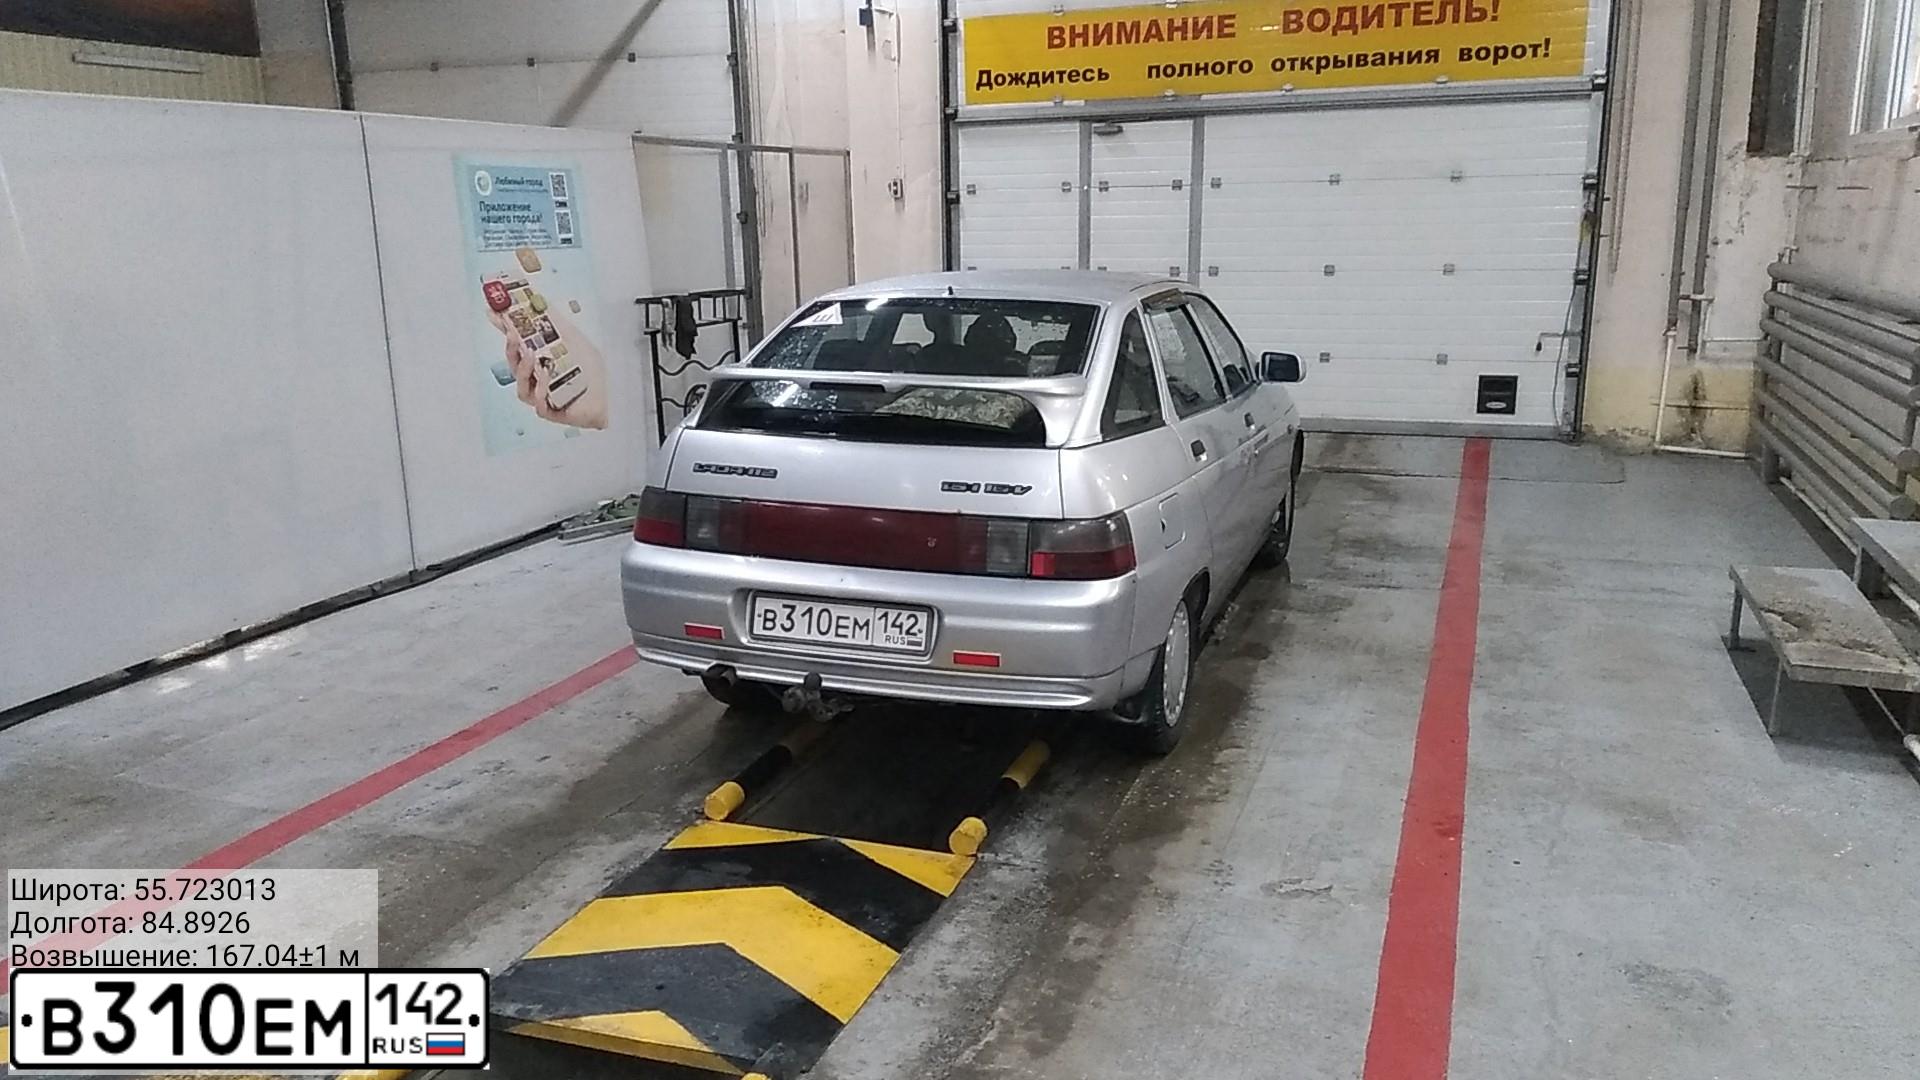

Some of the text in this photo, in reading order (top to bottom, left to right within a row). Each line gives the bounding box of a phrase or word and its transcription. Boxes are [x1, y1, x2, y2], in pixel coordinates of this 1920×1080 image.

[1047, 0, 1500, 50] ВНИМАНИЕ ВОДИТЕЛЬ!
[975, 37, 1552, 91] Дождитесь полного открывания ворот!
[479, 200, 532, 214] Приложение
[481, 214, 512, 224] нашего
[762, 603, 919, 641] В310ЕМ 142
[885, 634, 906, 645] RUS
